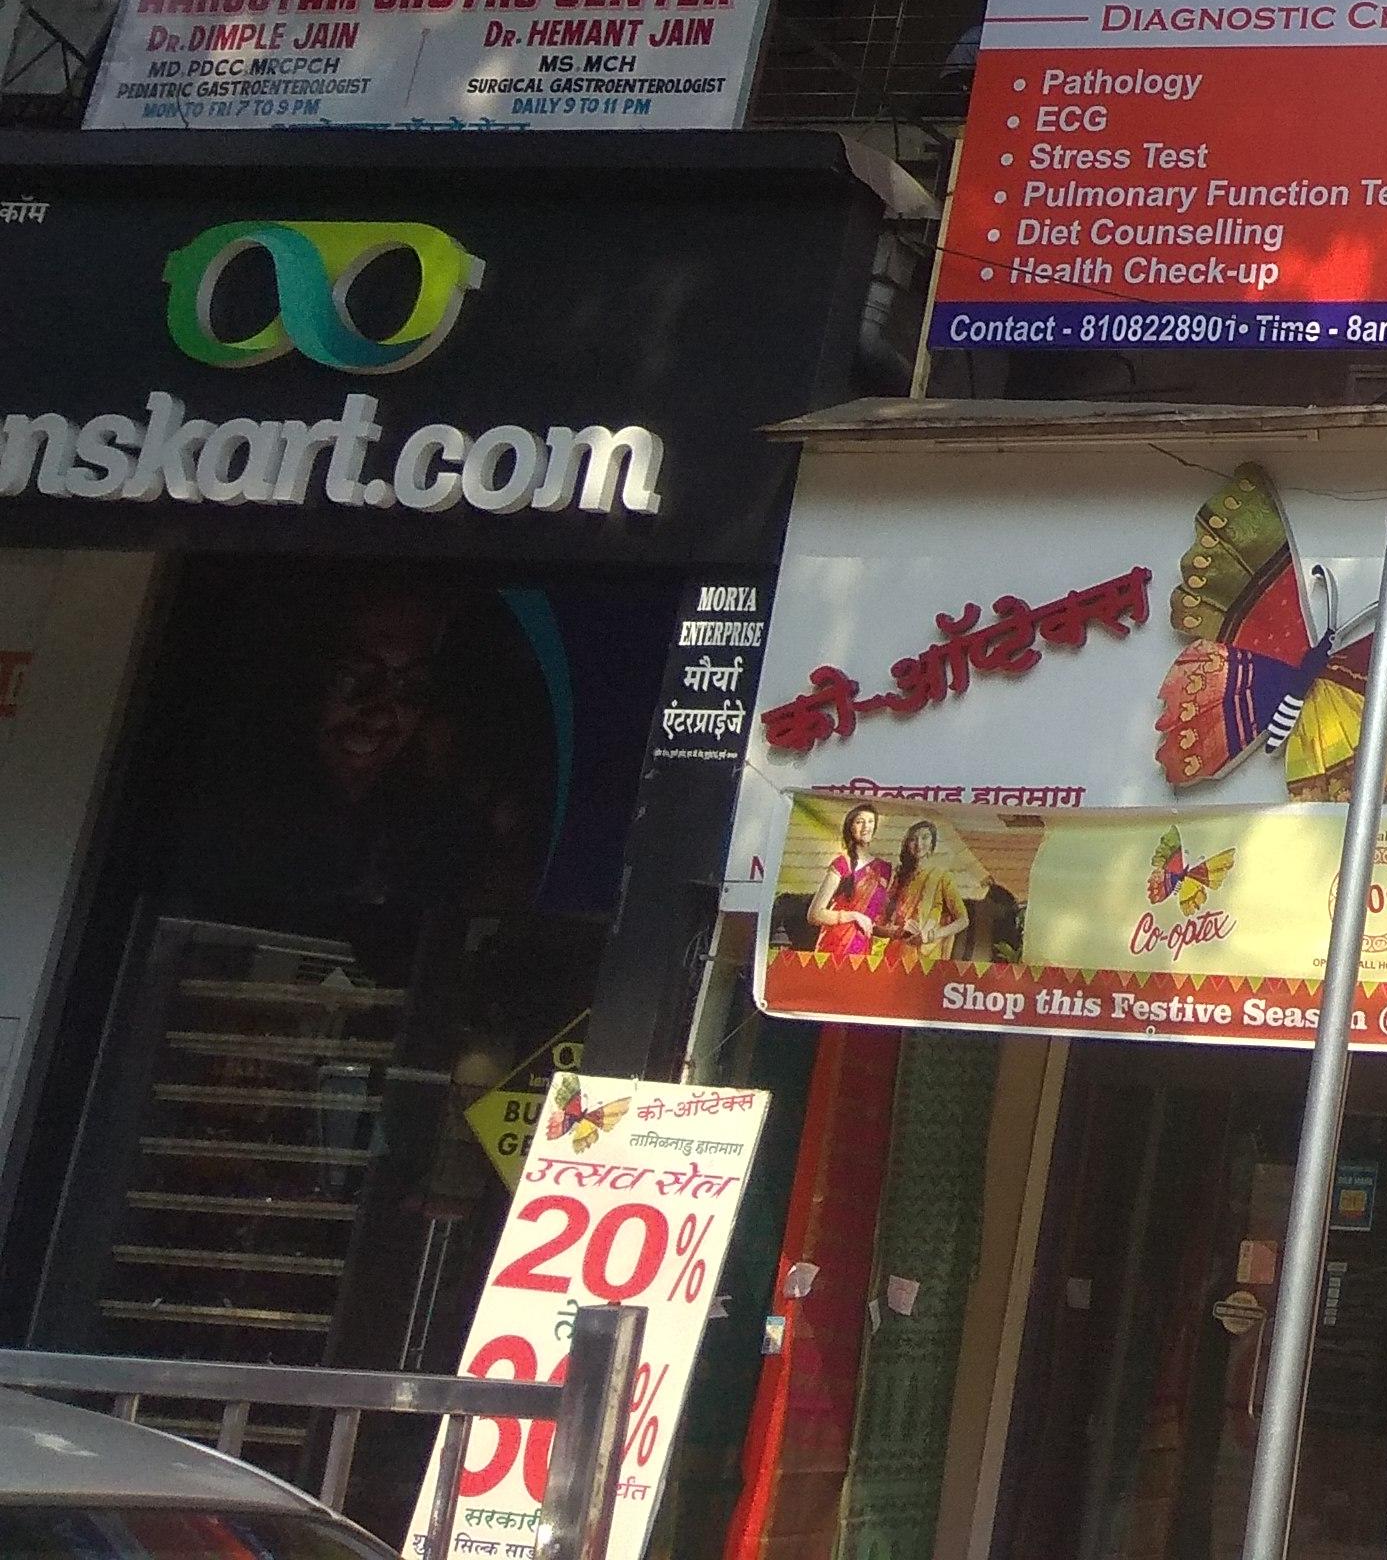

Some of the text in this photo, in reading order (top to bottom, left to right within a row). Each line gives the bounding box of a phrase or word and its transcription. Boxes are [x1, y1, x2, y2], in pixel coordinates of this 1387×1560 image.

[1101, 3, 1337, 32] DIAGNOSTIC
[294, 22, 360, 49] JAIN
[650, 18, 714, 47] JAIN
[196, 79, 372, 97] GASTROENTEROLOGIST
[467, 78, 726, 93] SURGICAL GASTROENTEROLOGIST
[1043, 68, 1202, 100] Pathology
[512, 98, 651, 114] DAILY PM
[1036, 106, 1108, 132] ECG
[1029, 142, 1207, 169] Stress Test
[1023, 180, 1197, 213] Pulmonary
[1207, 179, 1350, 206] Function
[1016, 218, 1283, 250] Diet Counselling
[1010, 256, 1279, 290] Health Check-up
[950, 314, 1055, 341] Contact
[1256, 314, 1321, 341] Time
[697, 587, 756, 611] MORYA
[679, 621, 764, 647] ENTERPRISE
[1130, 911, 1237, 961] Co-optex
[943, 983, 1024, 1019] Shop
[1035, 989, 1102, 1018] this
[1111, 996, 1232, 1025] Festive
[1243, 999, 1365, 1030] Seasn
[655, 1162, 740, 1198] सेल
[492, 1194, 715, 1303] 20%
